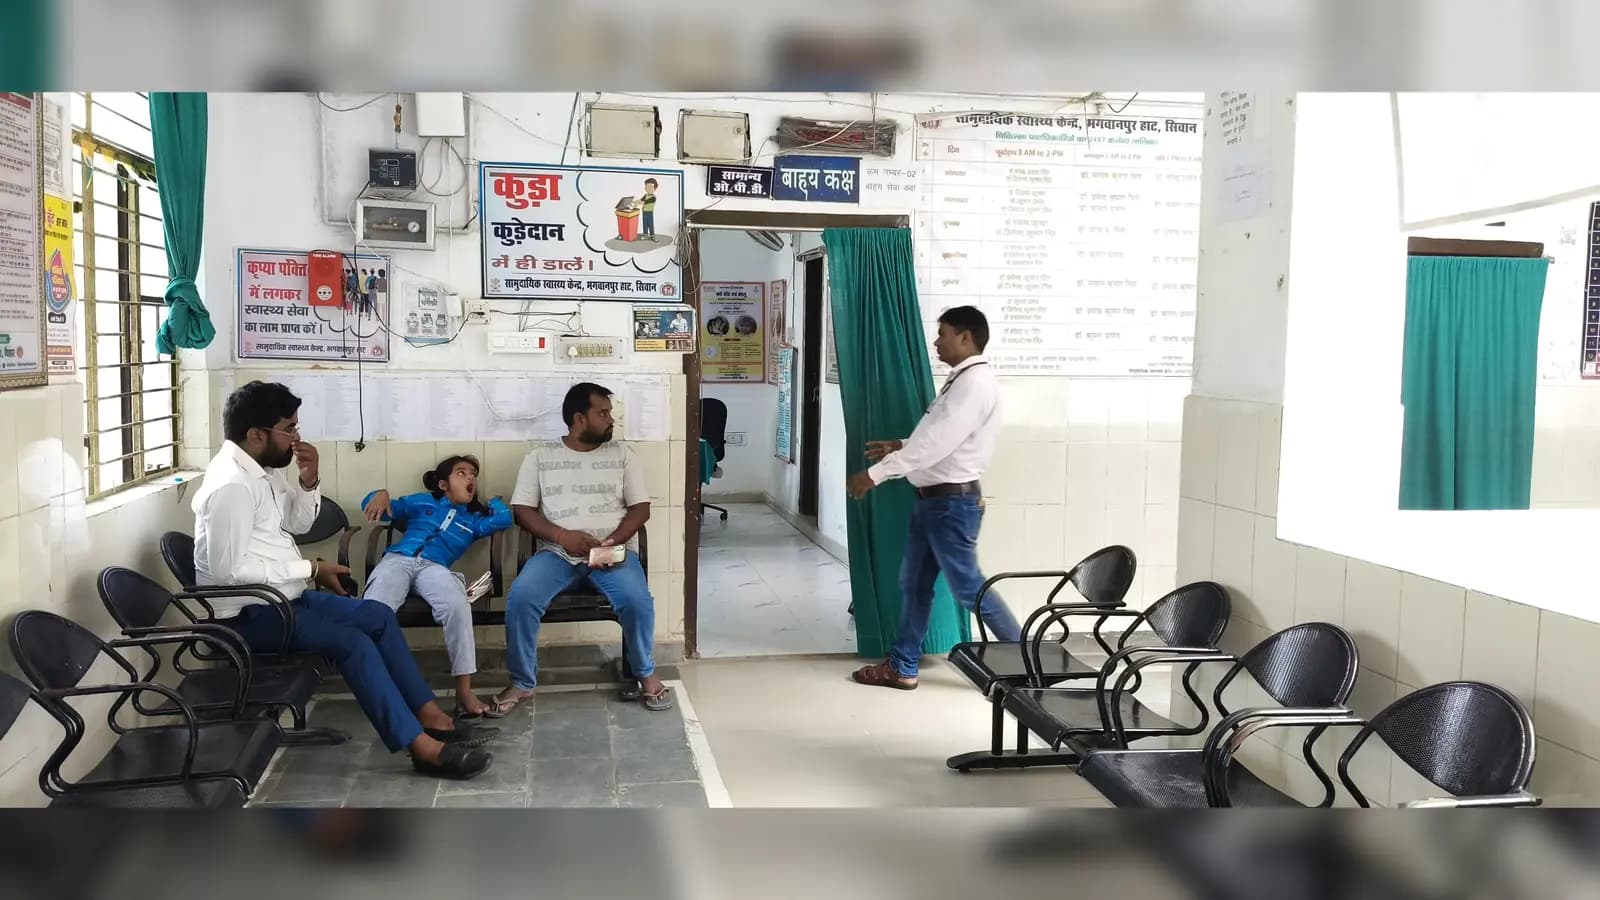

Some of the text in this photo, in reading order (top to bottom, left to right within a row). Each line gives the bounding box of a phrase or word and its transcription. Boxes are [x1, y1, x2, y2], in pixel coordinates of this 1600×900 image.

[1165, 119, 1197, 133] सिवान
[721, 170, 762, 182] सामान्य
[823, 167, 855, 195] कक्ष
[491, 254, 510, 269] में
[515, 254, 537, 270] ही
[504, 277, 541, 291] सामुदायिक
[636, 280, 657, 292] सिवान
[249, 284, 303, 300] में लगकर
[244, 303, 309, 316] स्वास्थ्य सेवा
[244, 322, 257, 333] का
[281, 324, 301, 334] प्राप्त
